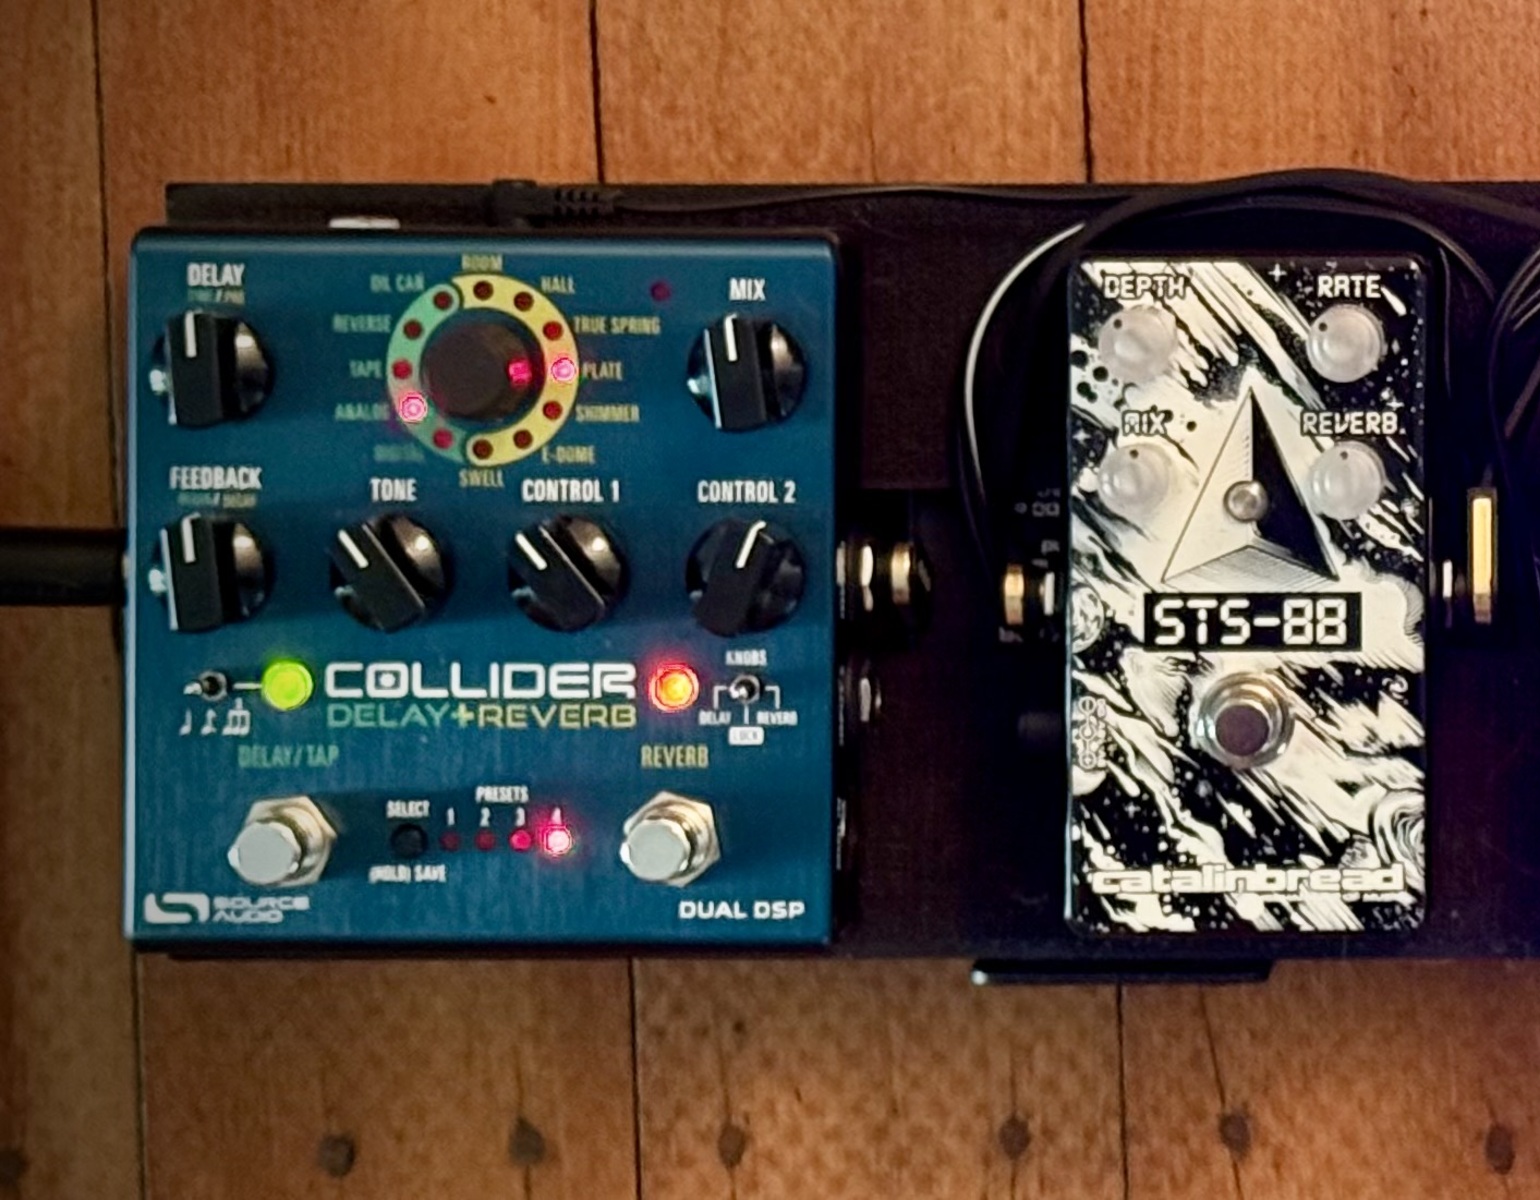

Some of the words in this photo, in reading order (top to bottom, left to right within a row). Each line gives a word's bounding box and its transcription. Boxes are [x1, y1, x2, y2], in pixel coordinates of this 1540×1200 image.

[461, 254, 503, 271] ROOM
[187, 262, 245, 286] DELAY
[395, 272, 424, 292] CAN
[541, 276, 575, 295] HALL
[729, 279, 766, 300] MIX
[1104, 275, 1187, 300] DEPTH
[1317, 274, 1381, 299] RATE
[333, 314, 391, 333] REVERSE
[574, 316, 607, 333] TRUE
[611, 317, 661, 334] SPRING
[350, 361, 382, 378] TAPE
[583, 361, 623, 379] PLATE
[576, 404, 640, 421] SHIMMER
[1122, 411, 1168, 436] MIX
[1302, 411, 1398, 435] REVERB
[169, 466, 262, 490] FEEDBACK
[459, 470, 504, 487] SWELL
[370, 479, 417, 502] TONE
[521, 480, 604, 502] CONTROL
[611, 480, 620, 502] 1
[697, 480, 777, 502] CONTROL
[783, 480, 797, 502] 2
[1154, 598, 1348, 646] STS-88
[725, 650, 767, 666] KNOBS
[325, 662, 637, 700] COLLIDER
[757, 710, 798, 726] REVERB
[641, 745, 709, 769] REVERB
[476, 785, 529, 803] PRESETS
[386, 800, 431, 818] SELECT
[447, 807, 455, 826] 1
[480, 807, 490, 827] 2
[515, 807, 525, 827] 3
[414, 865, 447, 883] SAVE
[1091, 863, 1405, 893] catalinbread
[213, 896, 310, 910] SOURCE
[679, 901, 747, 919] DUAL
[753, 901, 805, 919] DSP
[213, 910, 283, 923] AUDIO
